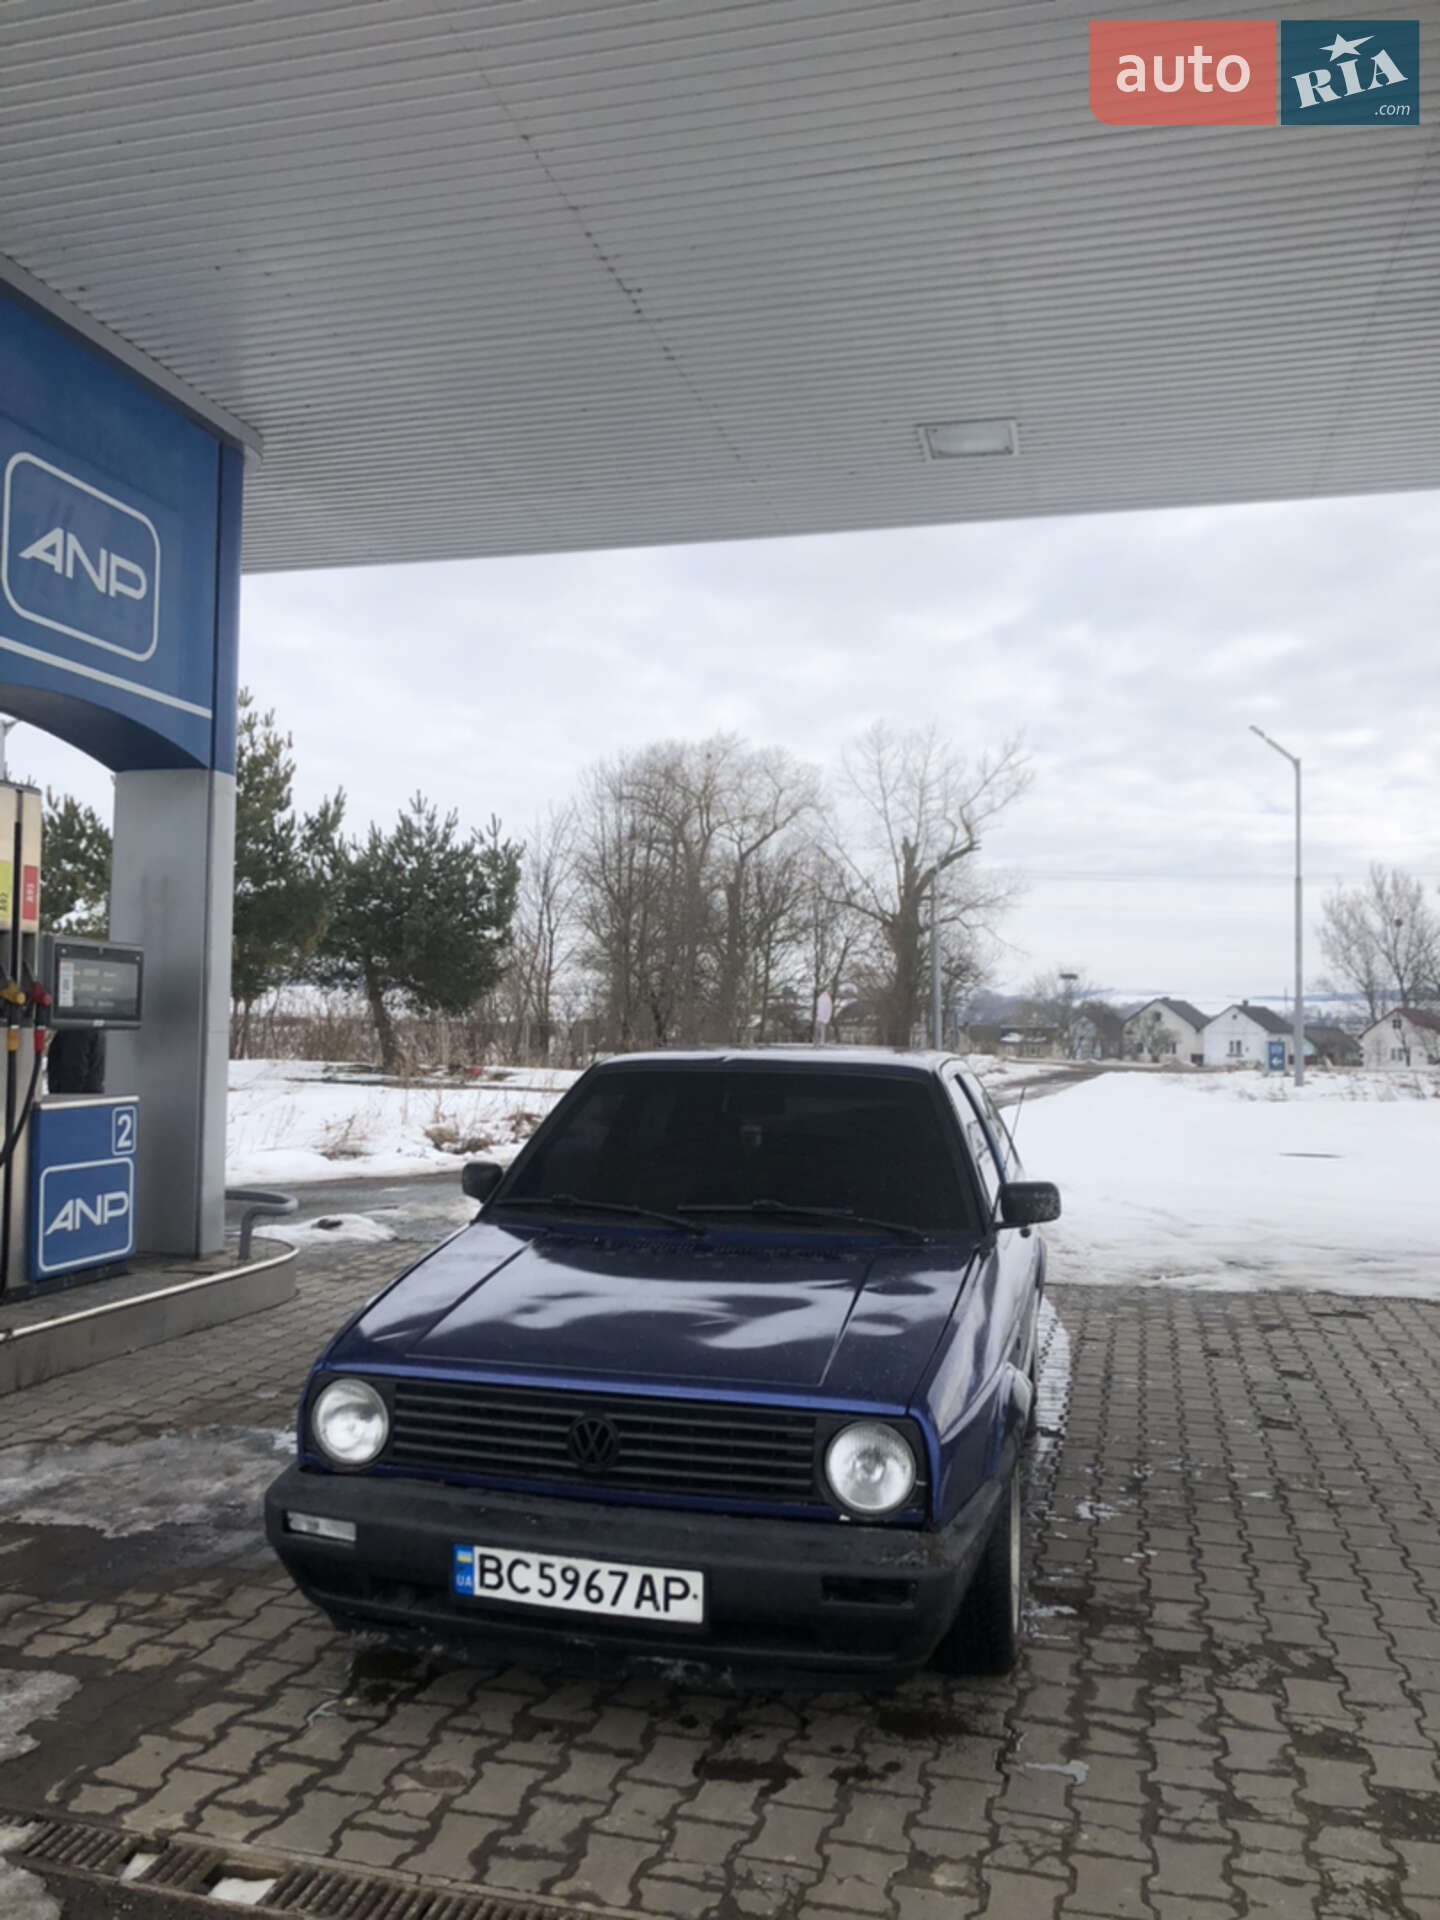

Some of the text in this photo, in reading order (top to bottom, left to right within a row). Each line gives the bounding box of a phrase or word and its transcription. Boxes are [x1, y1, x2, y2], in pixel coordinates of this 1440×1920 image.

[18, 527, 148, 601] ANP
[116, 1113, 133, 1149] 2
[44, 1190, 130, 1236] ANP
[455, 1574, 473, 1587] UA
